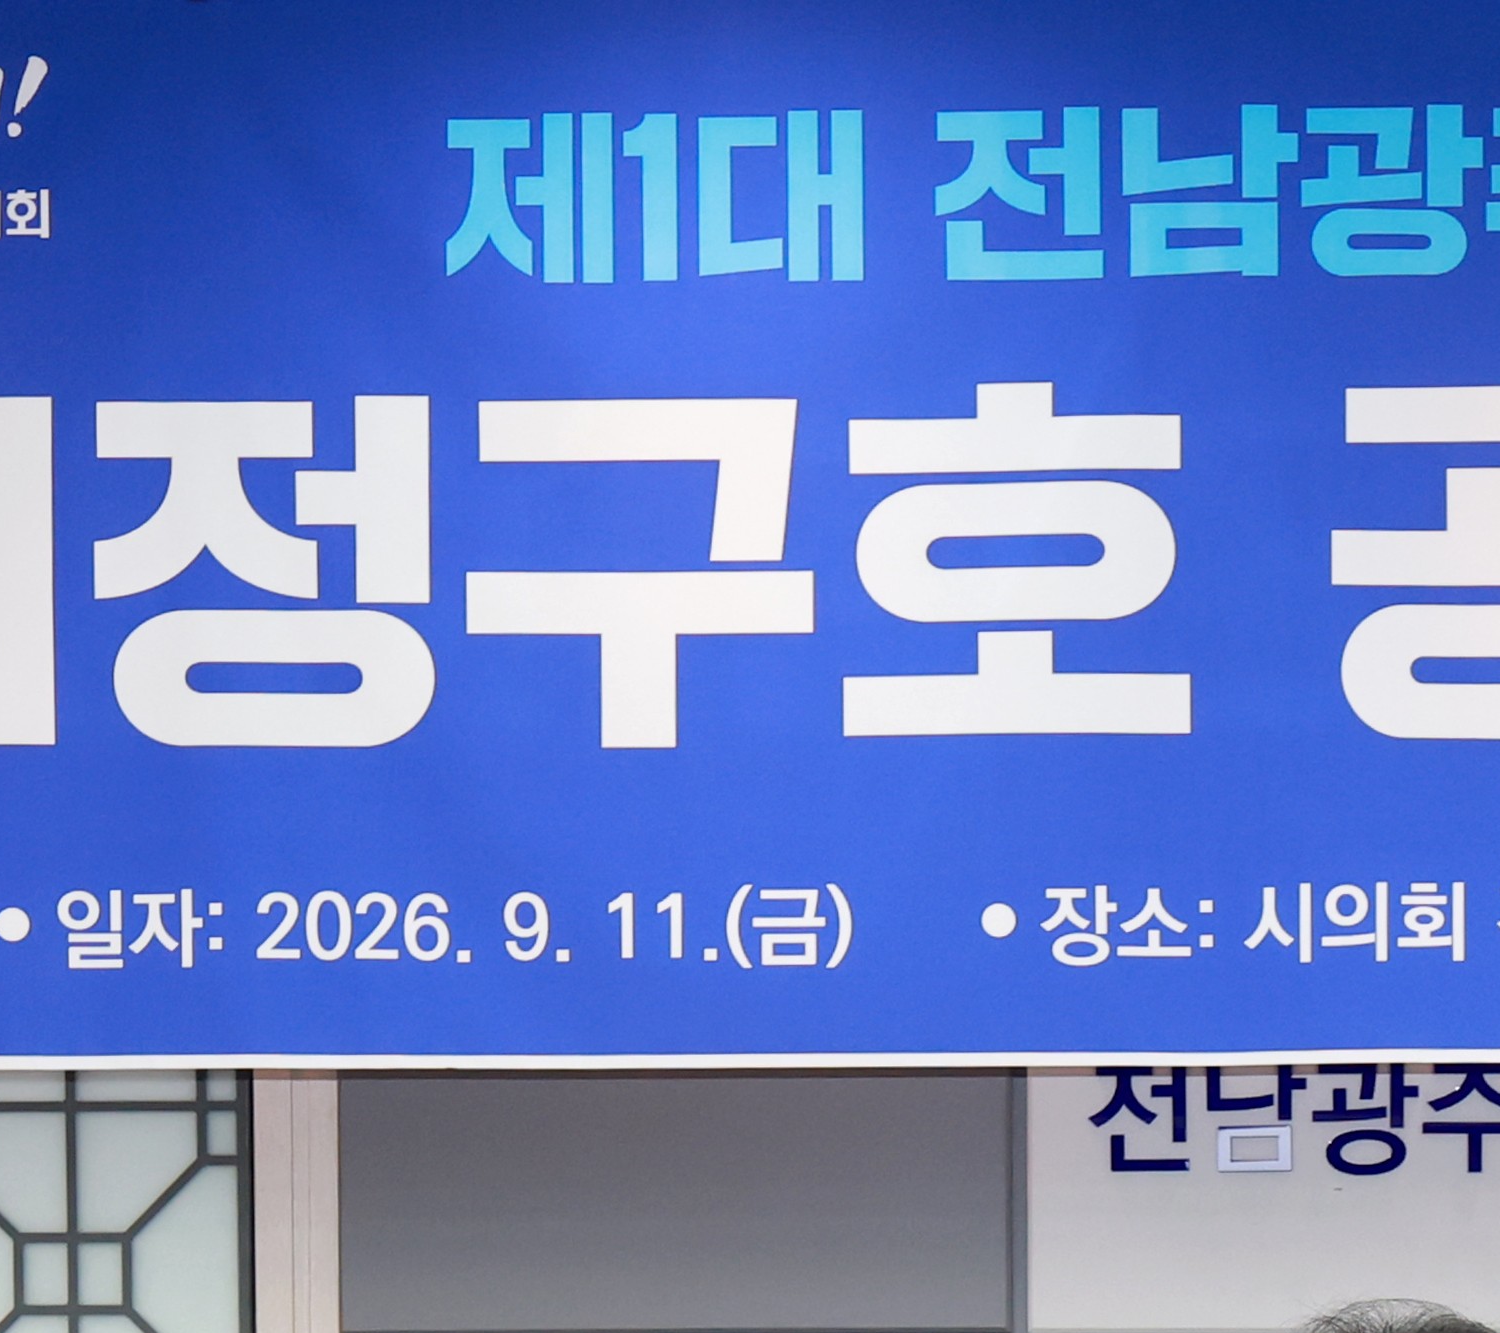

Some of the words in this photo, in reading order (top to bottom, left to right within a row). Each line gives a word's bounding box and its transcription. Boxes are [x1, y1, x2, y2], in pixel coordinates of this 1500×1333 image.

[446, 109, 864, 284] 제1대
[57, 888, 223, 969] 일자:
[256, 890, 471, 964] 2026.
[503, 891, 570, 963] 9.
[607, 883, 853, 969] 11.(금)
[1040, 884, 1214, 967] 장소:
[1243, 881, 1466, 964] 시의회
